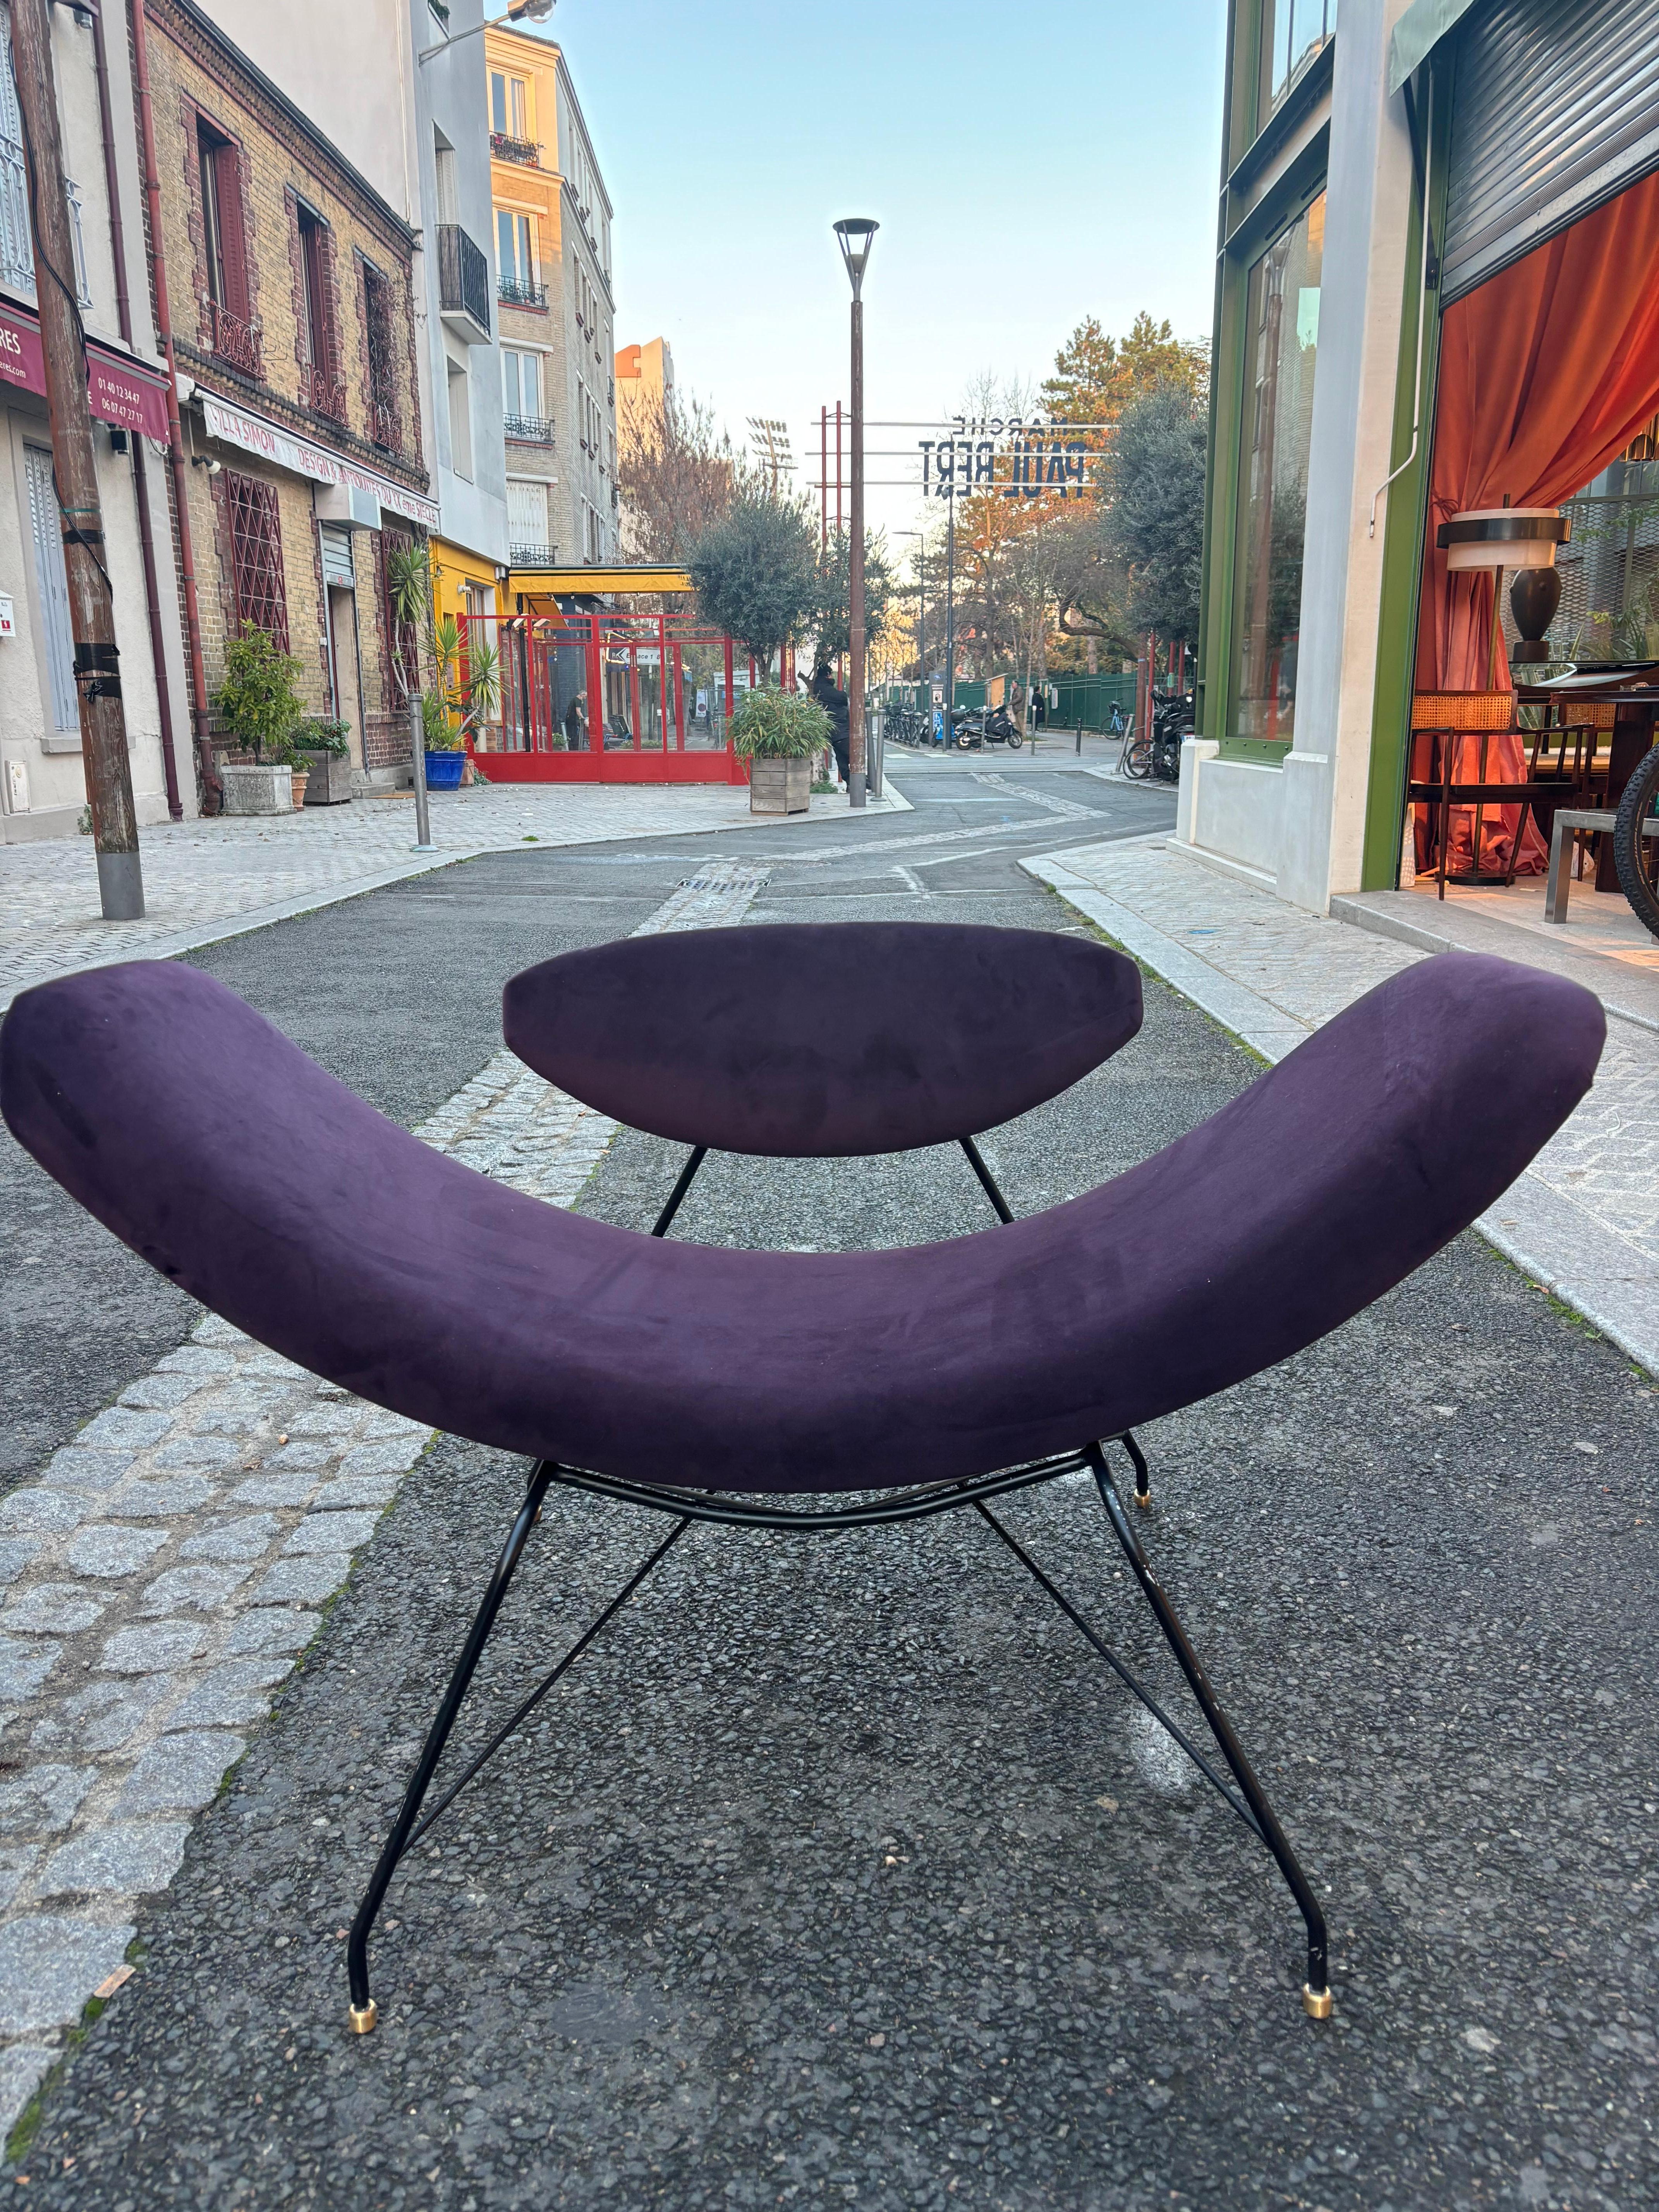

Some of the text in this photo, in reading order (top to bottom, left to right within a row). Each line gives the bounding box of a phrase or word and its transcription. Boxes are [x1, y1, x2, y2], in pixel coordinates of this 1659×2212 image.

[98, 377, 106, 390] 01
[107, 381, 115, 394] 40
[102, 398, 143, 424] 06 07 47 27 17
[242, 421, 275, 453] SIMON
[298, 448, 330, 477] DESIGN
[381, 486, 392, 505] DU
[392, 489, 402, 509] XX
